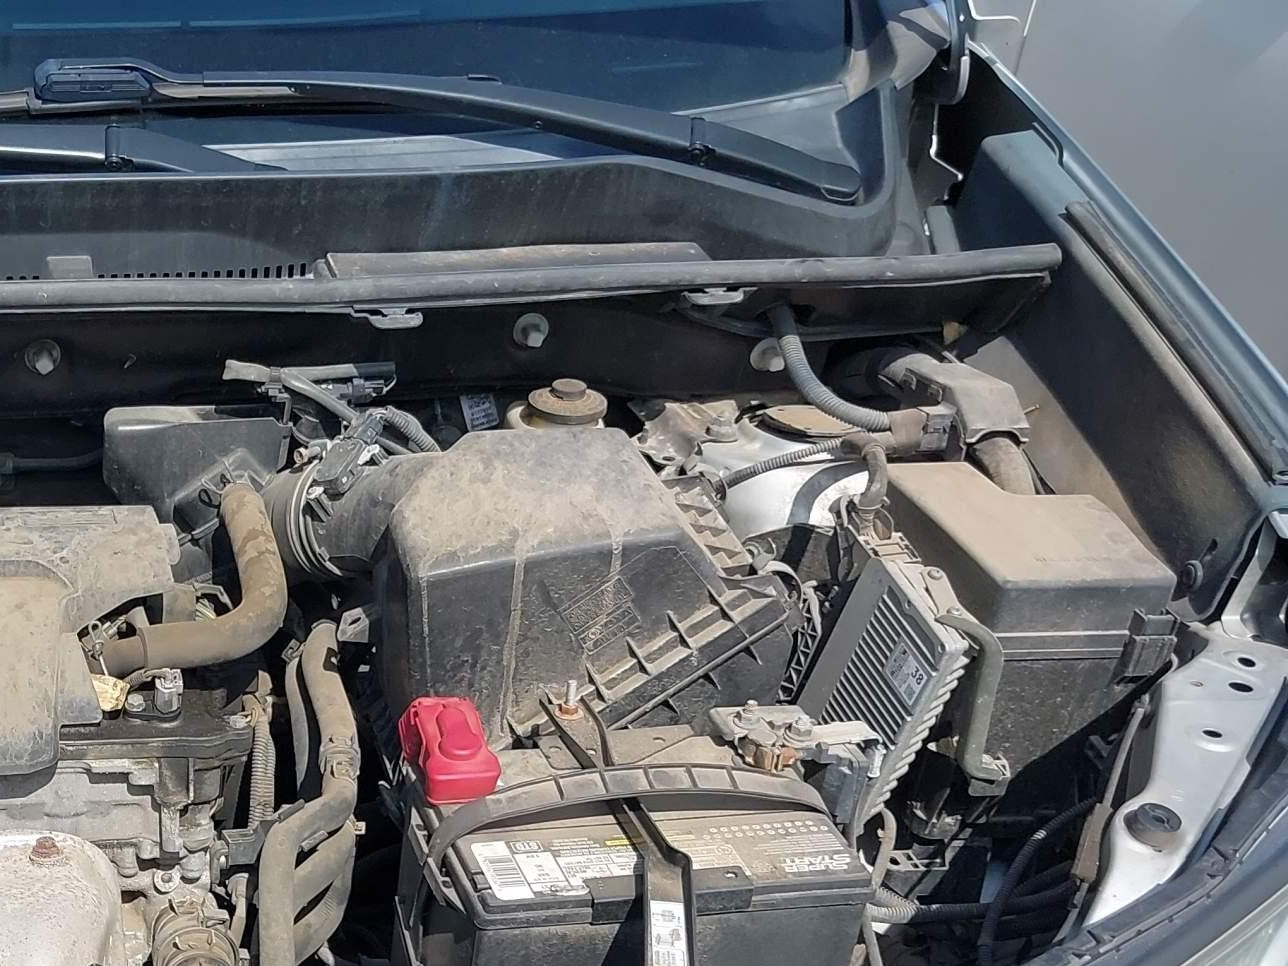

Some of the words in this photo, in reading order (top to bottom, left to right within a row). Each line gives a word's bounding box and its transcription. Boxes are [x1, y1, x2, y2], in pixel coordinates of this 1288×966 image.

[911, 665, 924, 685] 38
[781, 854, 851, 866] START
[784, 862, 849, 873] SUPER
